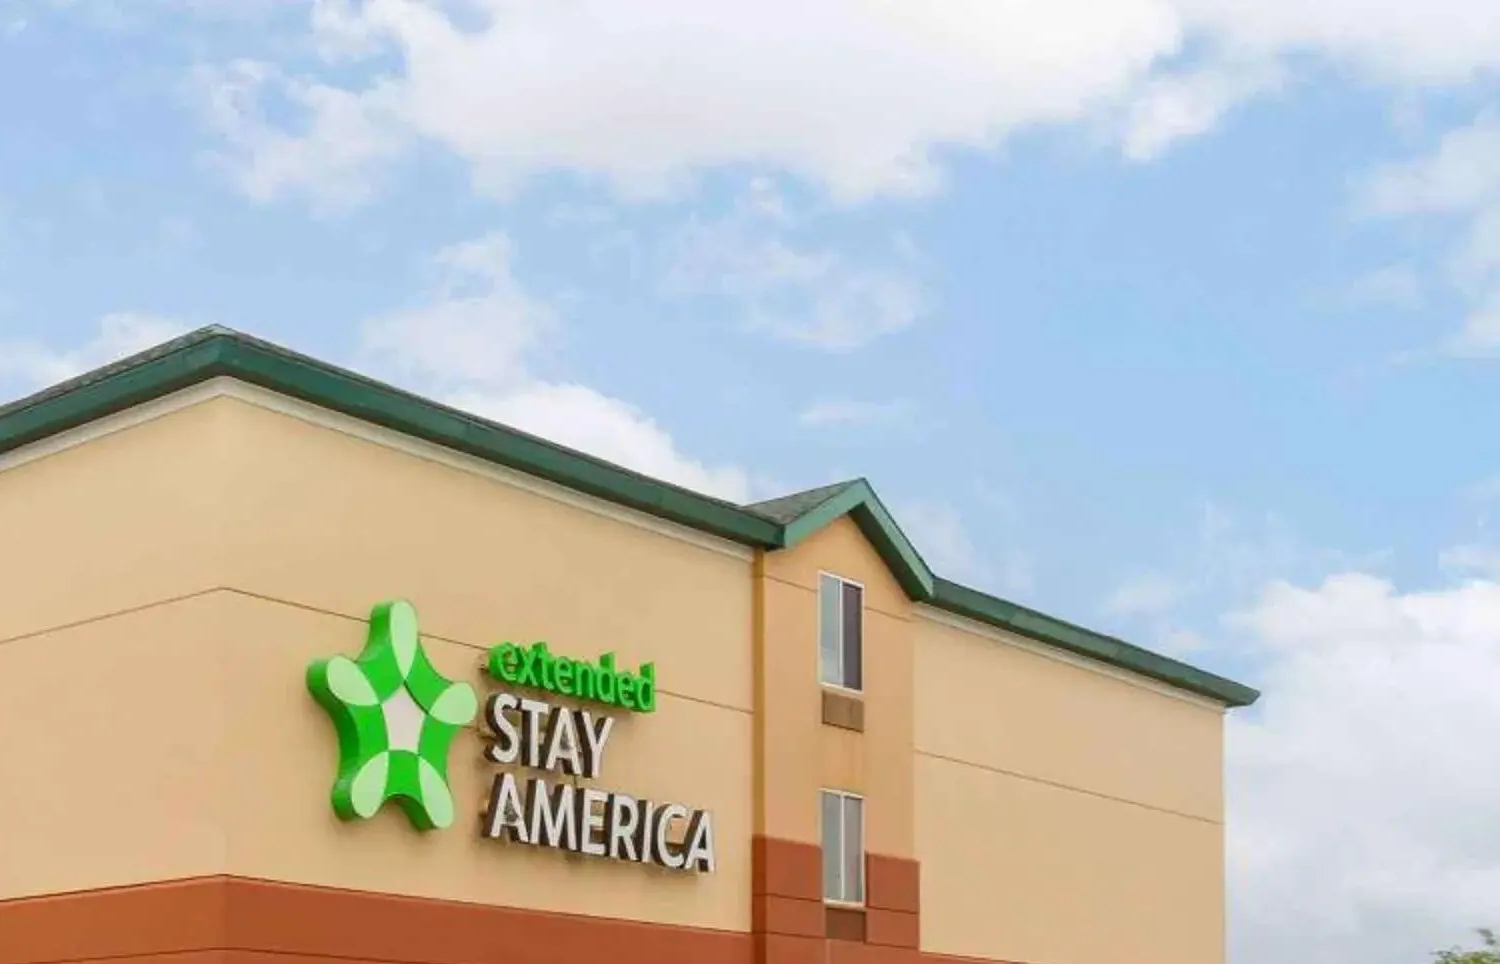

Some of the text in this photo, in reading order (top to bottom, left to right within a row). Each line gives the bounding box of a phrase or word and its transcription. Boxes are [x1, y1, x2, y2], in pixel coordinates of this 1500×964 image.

[489, 641, 656, 712] extended
[487, 692, 615, 778] STAY
[485, 772, 715, 873] AMERICA
